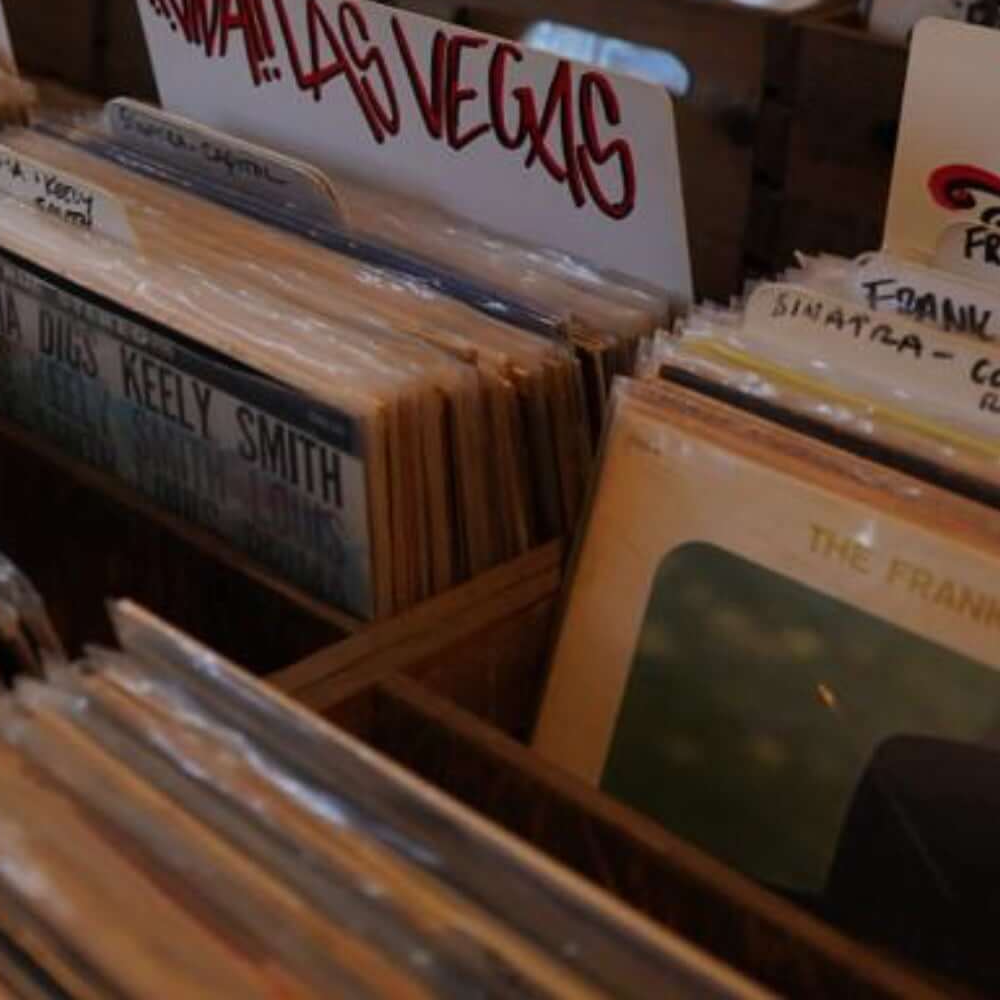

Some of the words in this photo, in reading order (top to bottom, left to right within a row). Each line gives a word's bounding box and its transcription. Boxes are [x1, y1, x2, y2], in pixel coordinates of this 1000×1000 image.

[391, 14, 636, 220] VEGAS
[861, 278, 996, 342] FRANK
[37, 309, 99, 379] DIGS
[118, 344, 212, 438] KEELY
[234, 405, 343, 508] SMITH
[807, 523, 871, 574] THE
